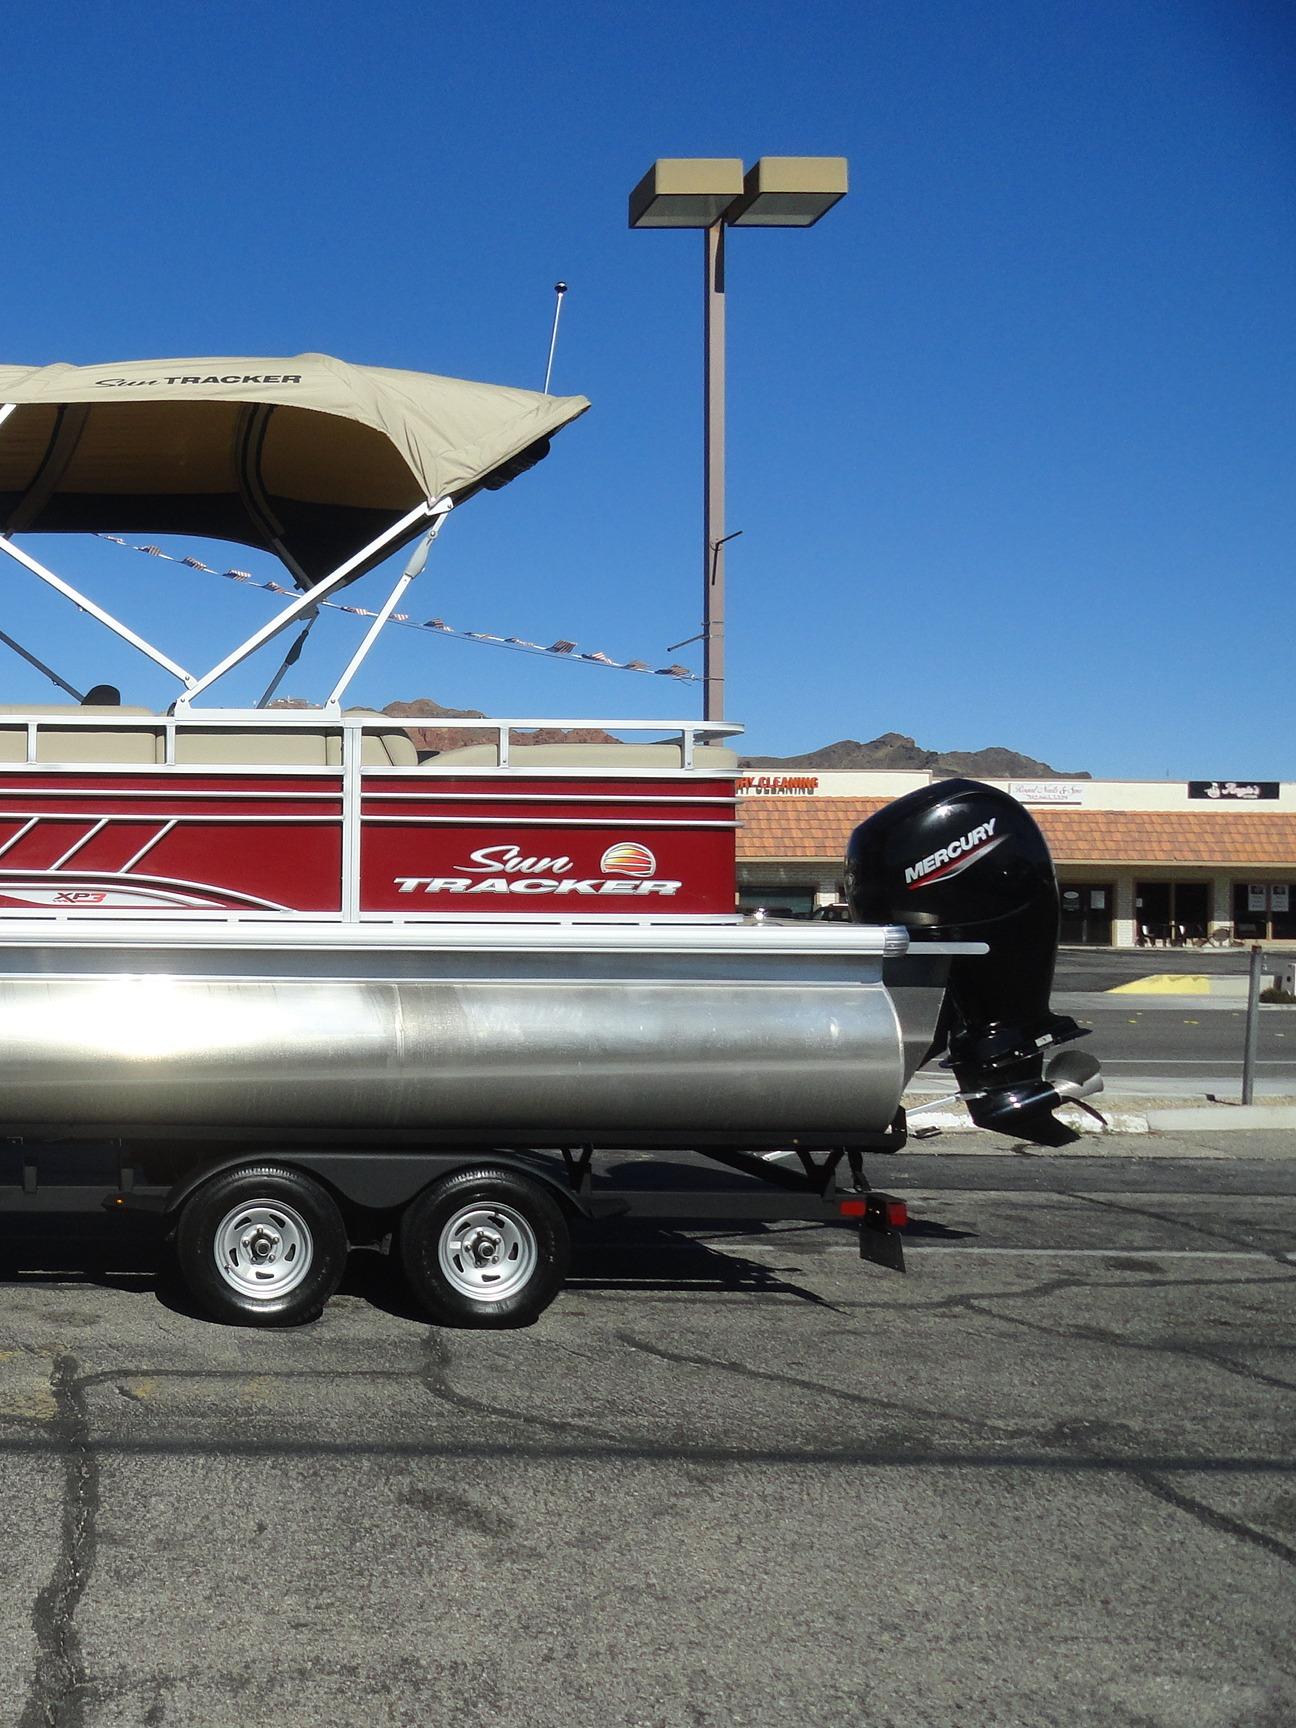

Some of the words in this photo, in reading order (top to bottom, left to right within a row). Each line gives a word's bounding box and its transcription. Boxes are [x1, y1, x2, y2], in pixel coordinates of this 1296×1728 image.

[95, 378, 161, 388] Sun
[164, 375, 302, 385] TRACKER
[757, 776, 819, 789] CLEANING
[904, 818, 996, 884] MERCURY
[453, 845, 573, 874] Sun
[394, 877, 683, 896] TRACKER
[53, 892, 107, 904] XP3
